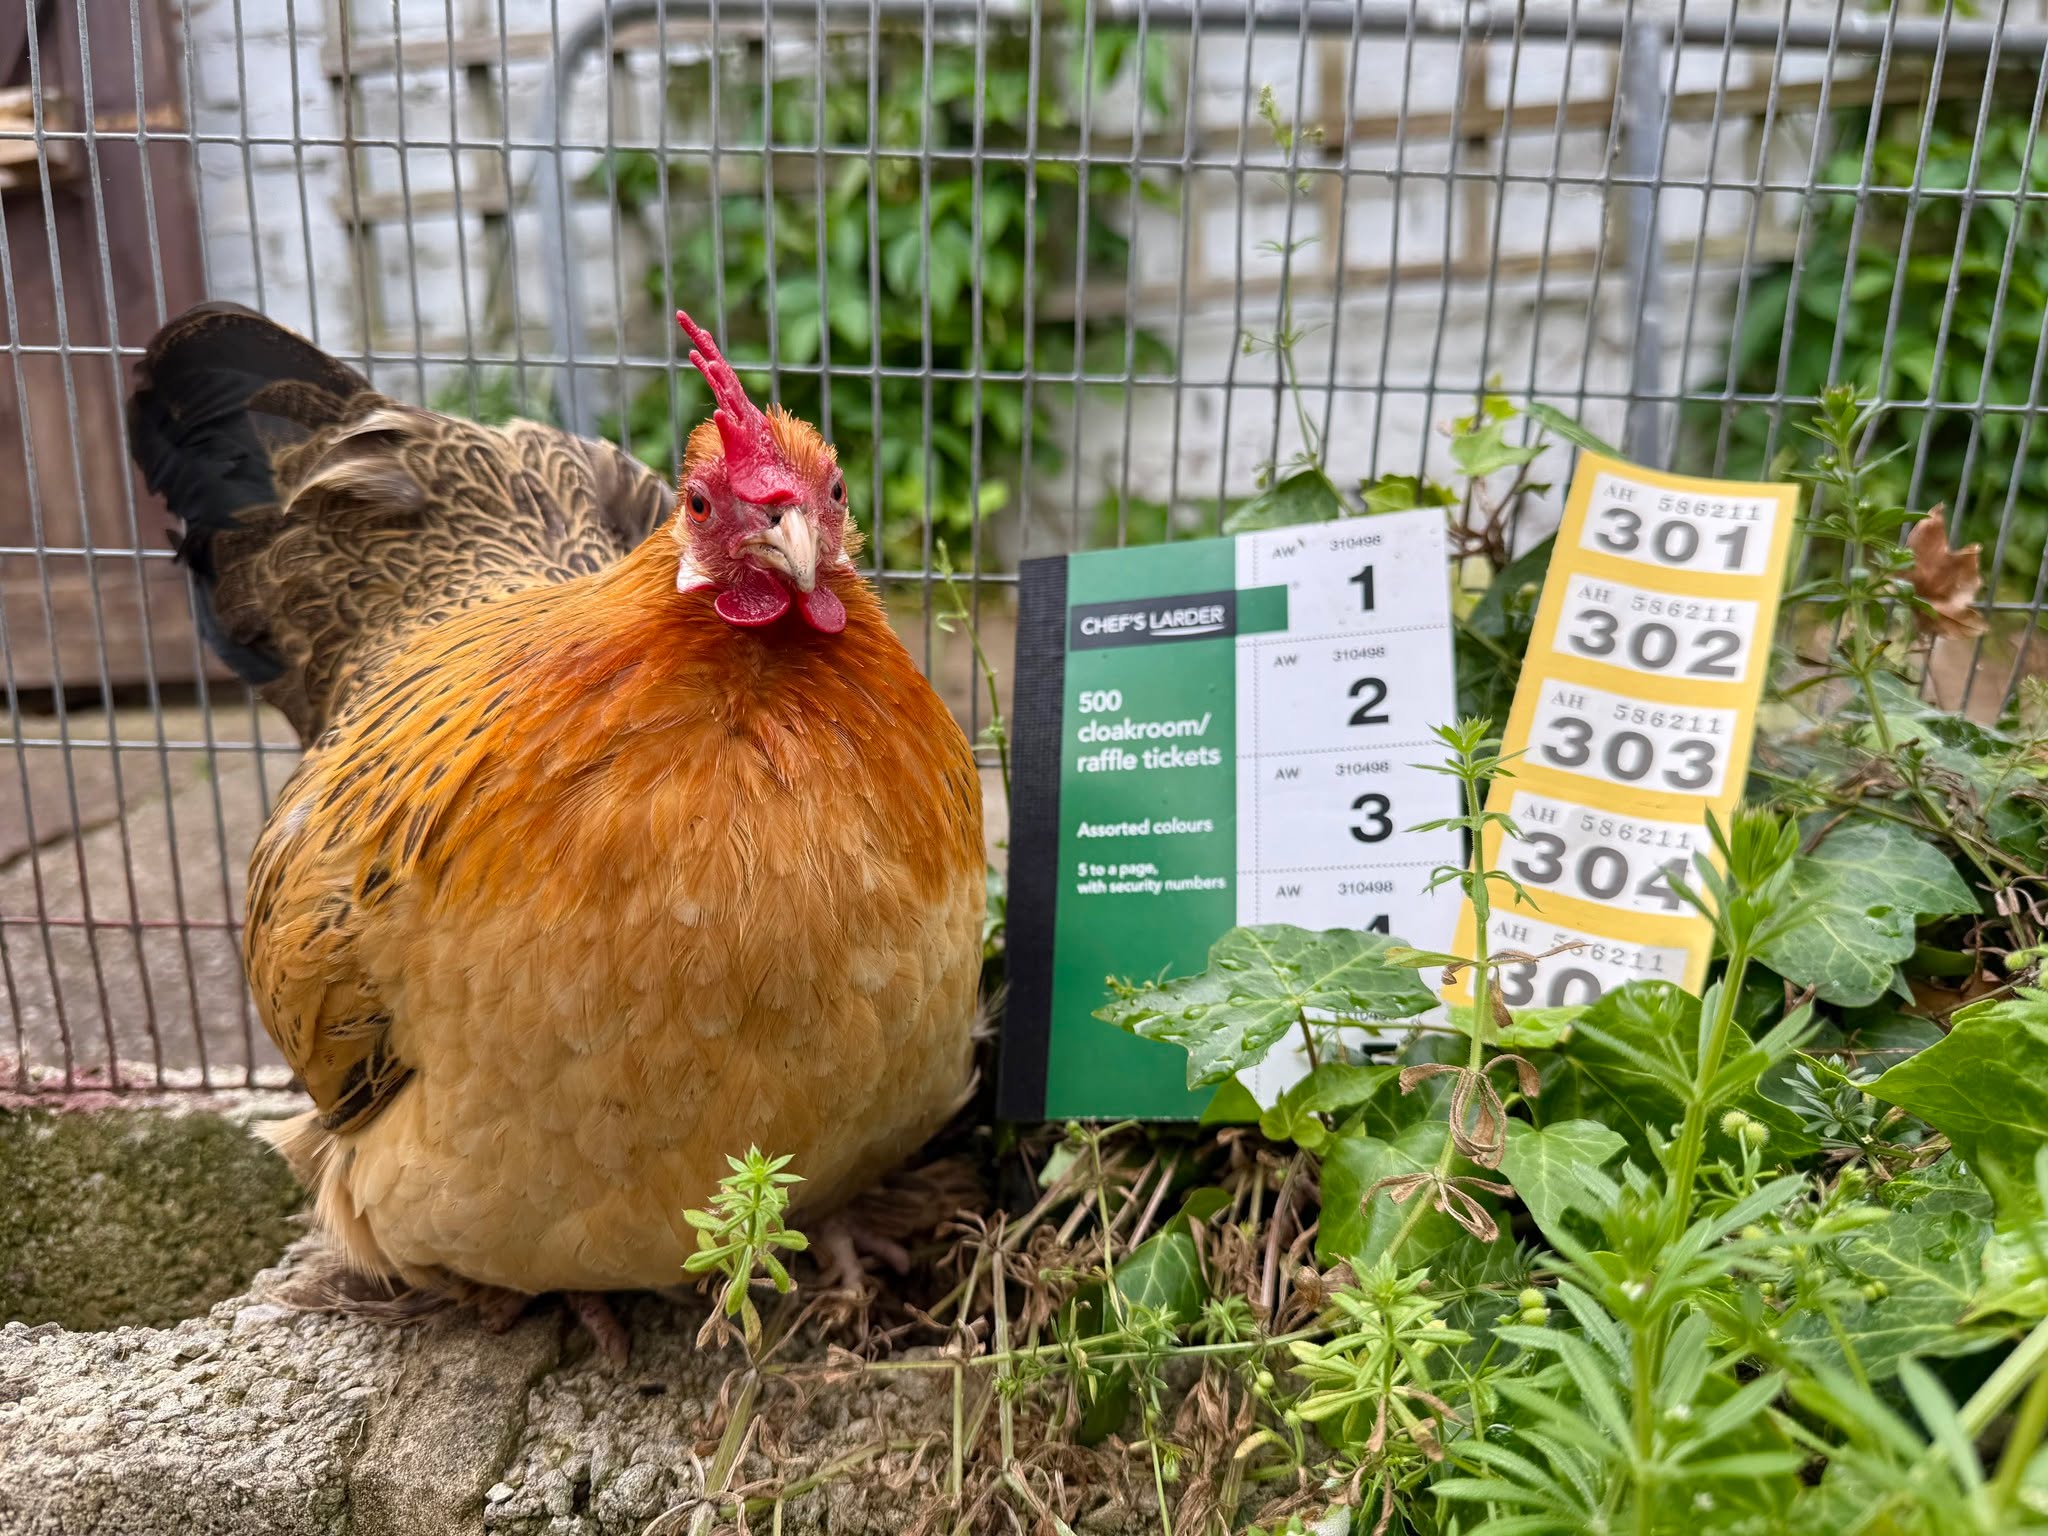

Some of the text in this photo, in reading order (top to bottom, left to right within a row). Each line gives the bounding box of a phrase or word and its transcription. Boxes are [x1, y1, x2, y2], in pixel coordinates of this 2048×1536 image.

[1603, 483, 1760, 520] AH 586211
[1272, 534, 1381, 559] AW 310498
[1595, 508, 1749, 569] 301
[1348, 564, 1375, 612] 1
[1576, 584, 1736, 622] AH 586211
[1080, 604, 1226, 636] CHEF'S LARDER
[1274, 646, 1386, 668] AW 310498
[1569, 609, 1741, 676] 302
[1078, 690, 1122, 713] 500
[1347, 677, 1389, 726] 2
[1550, 690, 1724, 734] AH 586211
[1077, 712, 1211, 743] cloakroom/
[1077, 745, 1222, 773] raffle tickets
[1275, 761, 1389, 780] AW 310498
[1540, 717, 1717, 790] 303
[1076, 816, 1213, 839] Assorted colours
[1350, 793, 1393, 843] 3
[1521, 803, 1694, 850] AH 586211
[1077, 862, 1159, 879] 5 to a page,
[1077, 875, 1226, 895] with security numbers
[1511, 831, 1690, 911] 304
[1276, 881, 1393, 898] AW 310498
[1493, 921, 1528, 943] AH
[1499, 957, 1601, 1008] 30
